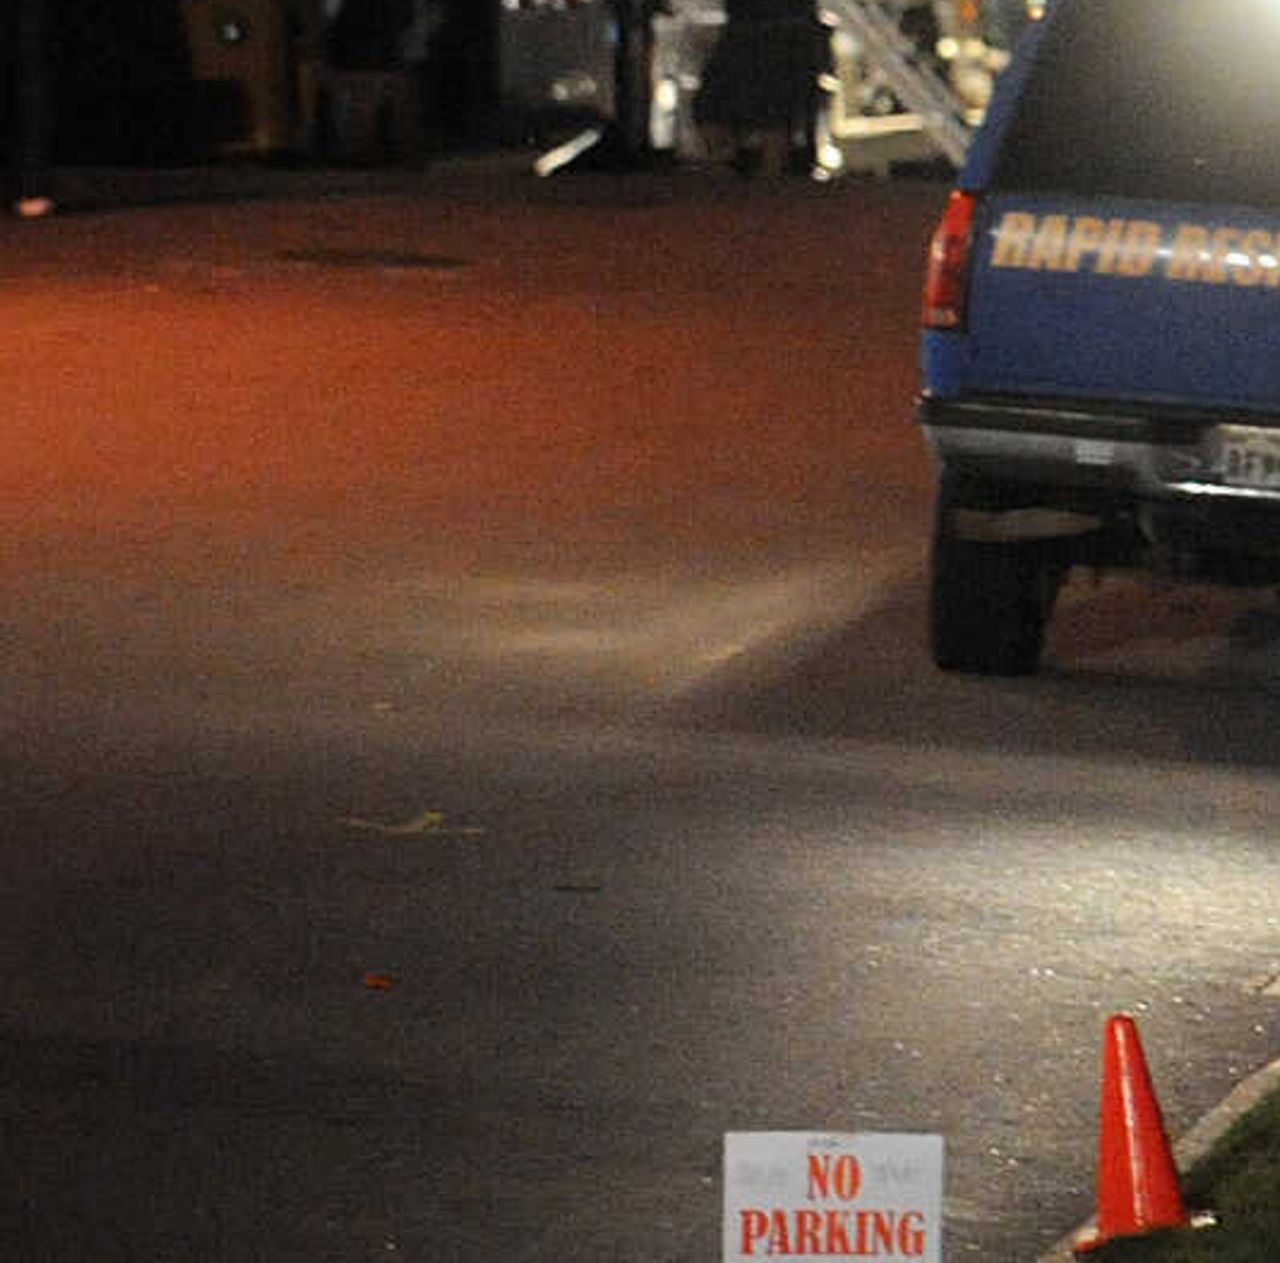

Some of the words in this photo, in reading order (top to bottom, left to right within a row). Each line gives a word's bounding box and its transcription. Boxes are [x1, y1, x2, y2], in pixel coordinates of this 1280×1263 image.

[992, 211, 1162, 276] RAPID
[807, 1154, 862, 1201] NO
[739, 1209, 926, 1257] PARKING
